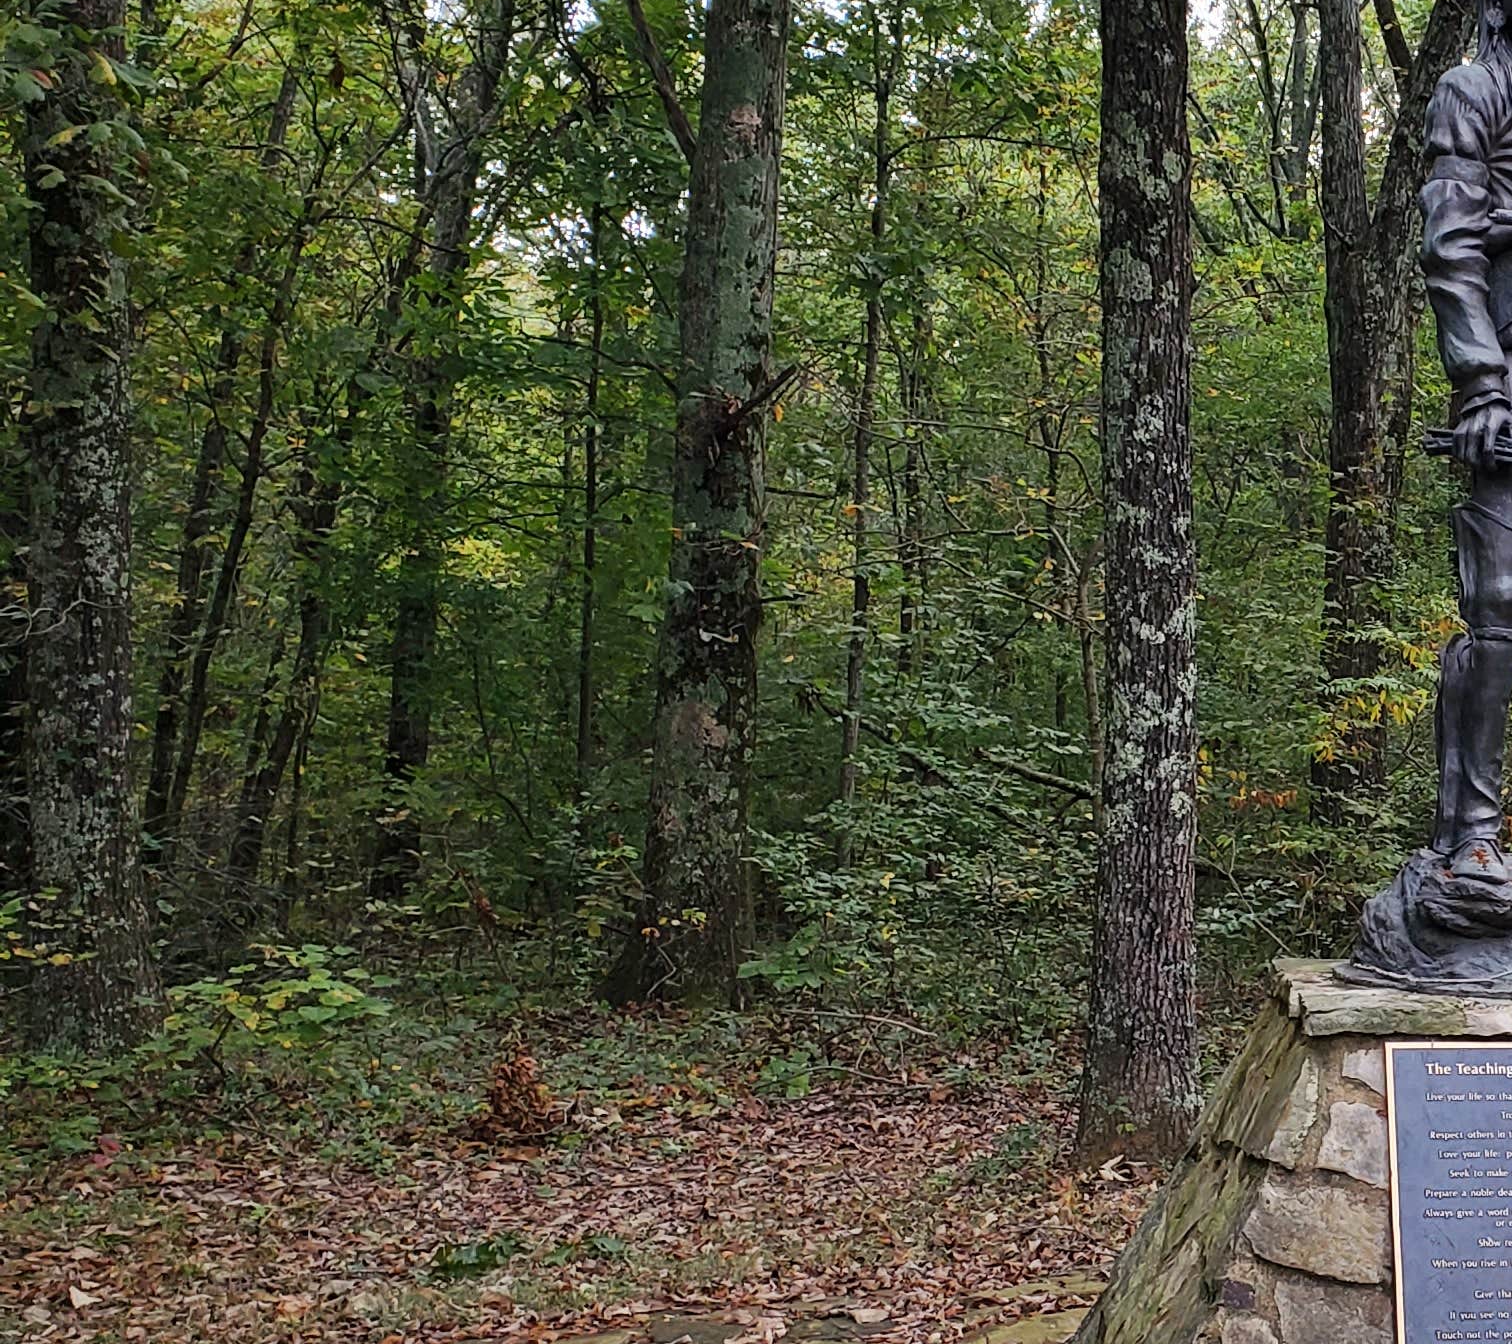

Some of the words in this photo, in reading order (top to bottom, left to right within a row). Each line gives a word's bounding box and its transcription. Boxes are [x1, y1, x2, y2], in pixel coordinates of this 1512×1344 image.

[1424, 1061, 1452, 1074] The
[1426, 1092, 1443, 1100] Live
[1446, 1093, 1465, 1101] your
[1468, 1091, 1482, 1100] life
[1429, 1129, 1463, 1140] Respect
[1466, 1129, 1494, 1138] others
[1496, 1129, 1506, 1138] in
[1449, 1168, 1470, 1177] Seek
[1473, 1168, 1483, 1177] to
[1485, 1168, 1509, 1177] make
[1424, 1187, 1458, 1198] Prepare
[1469, 1187, 1494, 1196] noble
[1477, 1238, 1501, 1247] Show
[1435, 1330, 1463, 1339] Touch
[1465, 1329, 1481, 1338] not
[1485, 1329, 1500, 1338] the
